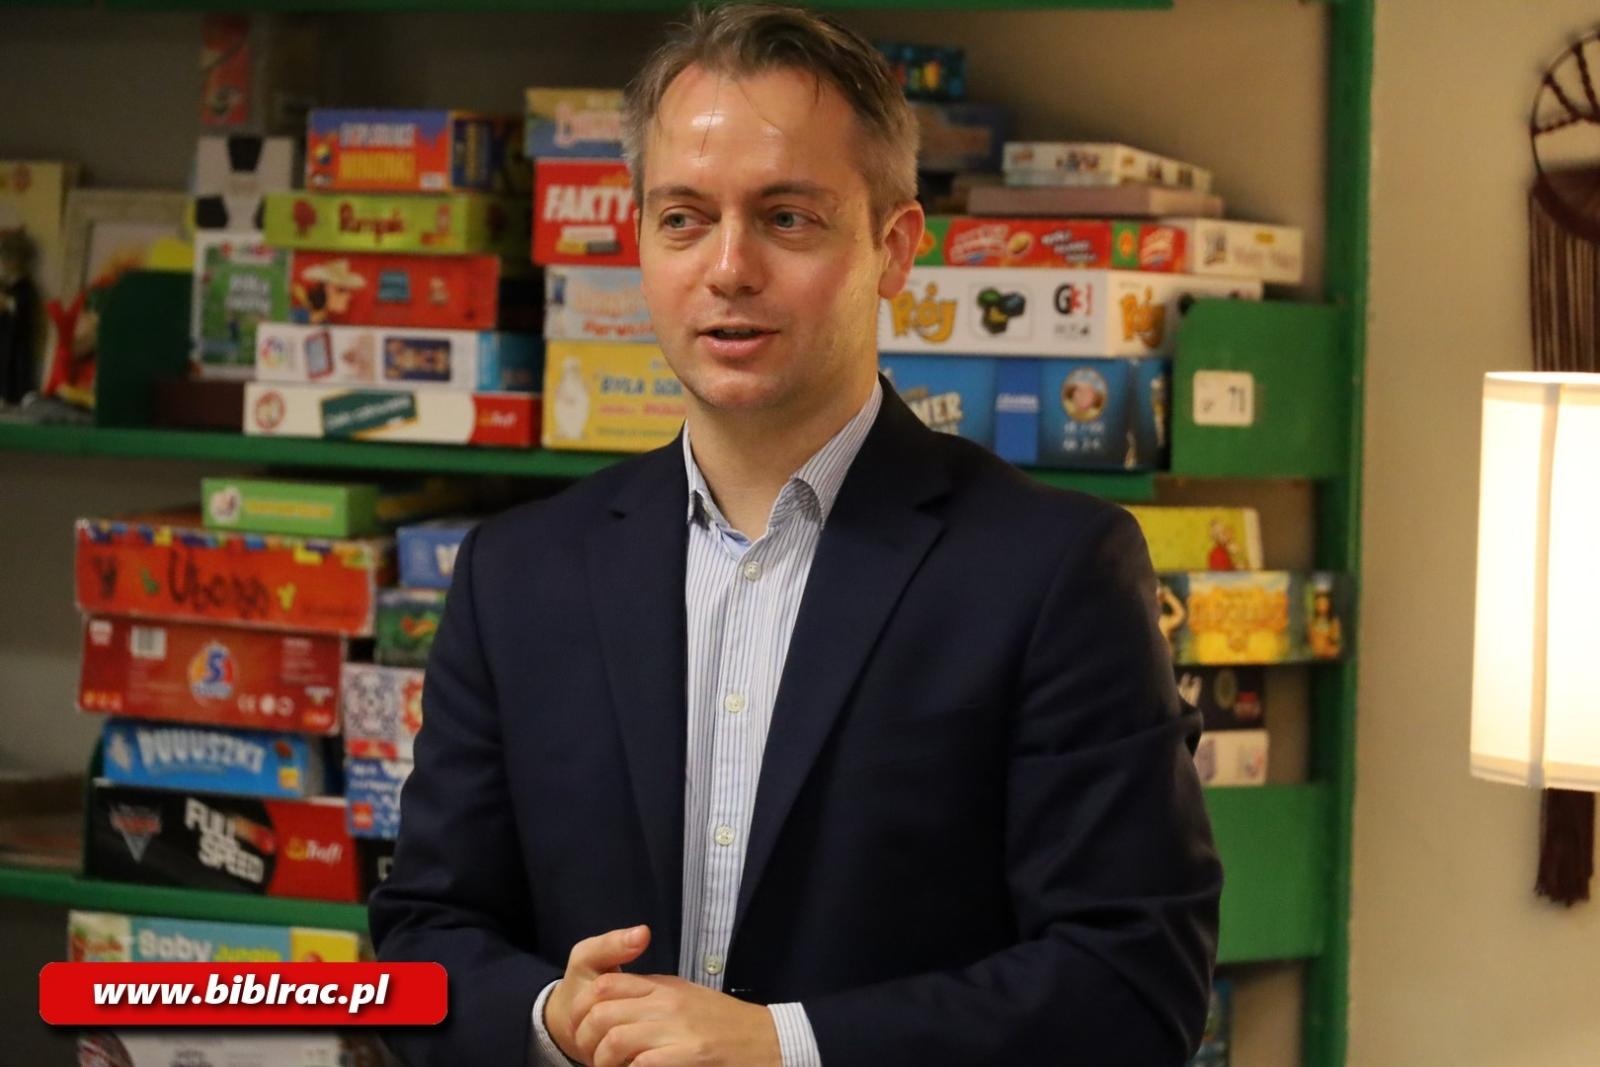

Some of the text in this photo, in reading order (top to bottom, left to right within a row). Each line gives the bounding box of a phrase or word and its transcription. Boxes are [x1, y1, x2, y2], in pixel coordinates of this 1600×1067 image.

[543, 185, 633, 223] FAKTY
[184, 797, 237, 838] FULL
[198, 829, 264, 884] SPEED
